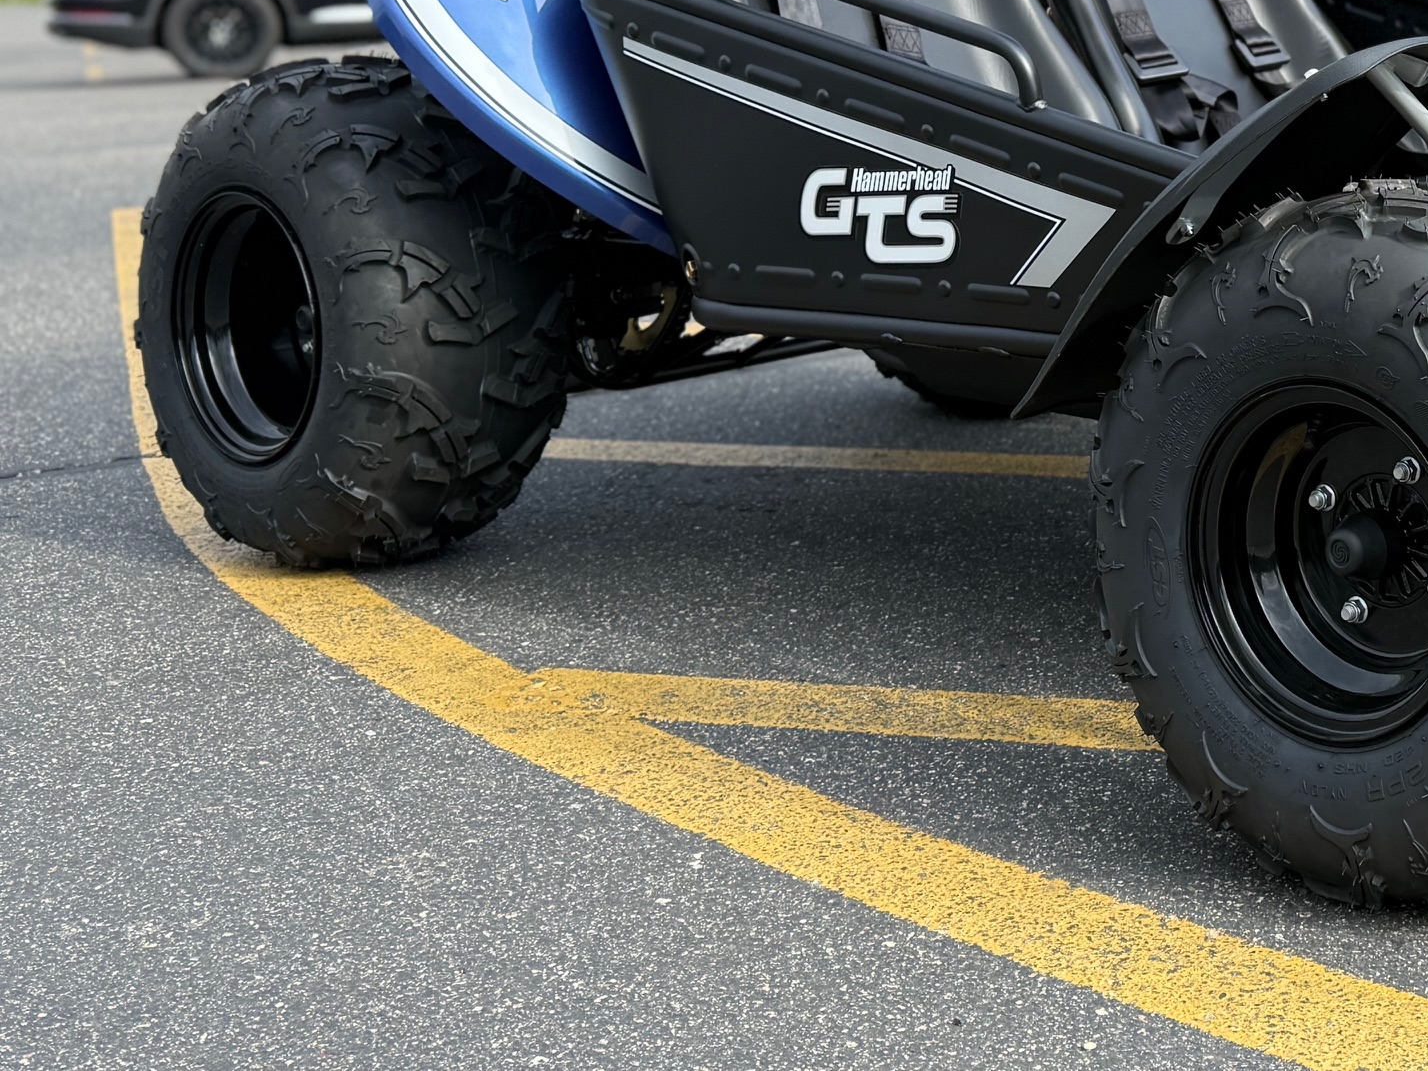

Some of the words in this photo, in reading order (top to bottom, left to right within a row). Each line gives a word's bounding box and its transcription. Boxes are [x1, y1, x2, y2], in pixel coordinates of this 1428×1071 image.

[851, 166, 952, 192] Hammerhead
[801, 167, 958, 263] GTS
[1151, 453, 1172, 512] WARNING
[1363, 758, 1428, 805] 2PR
